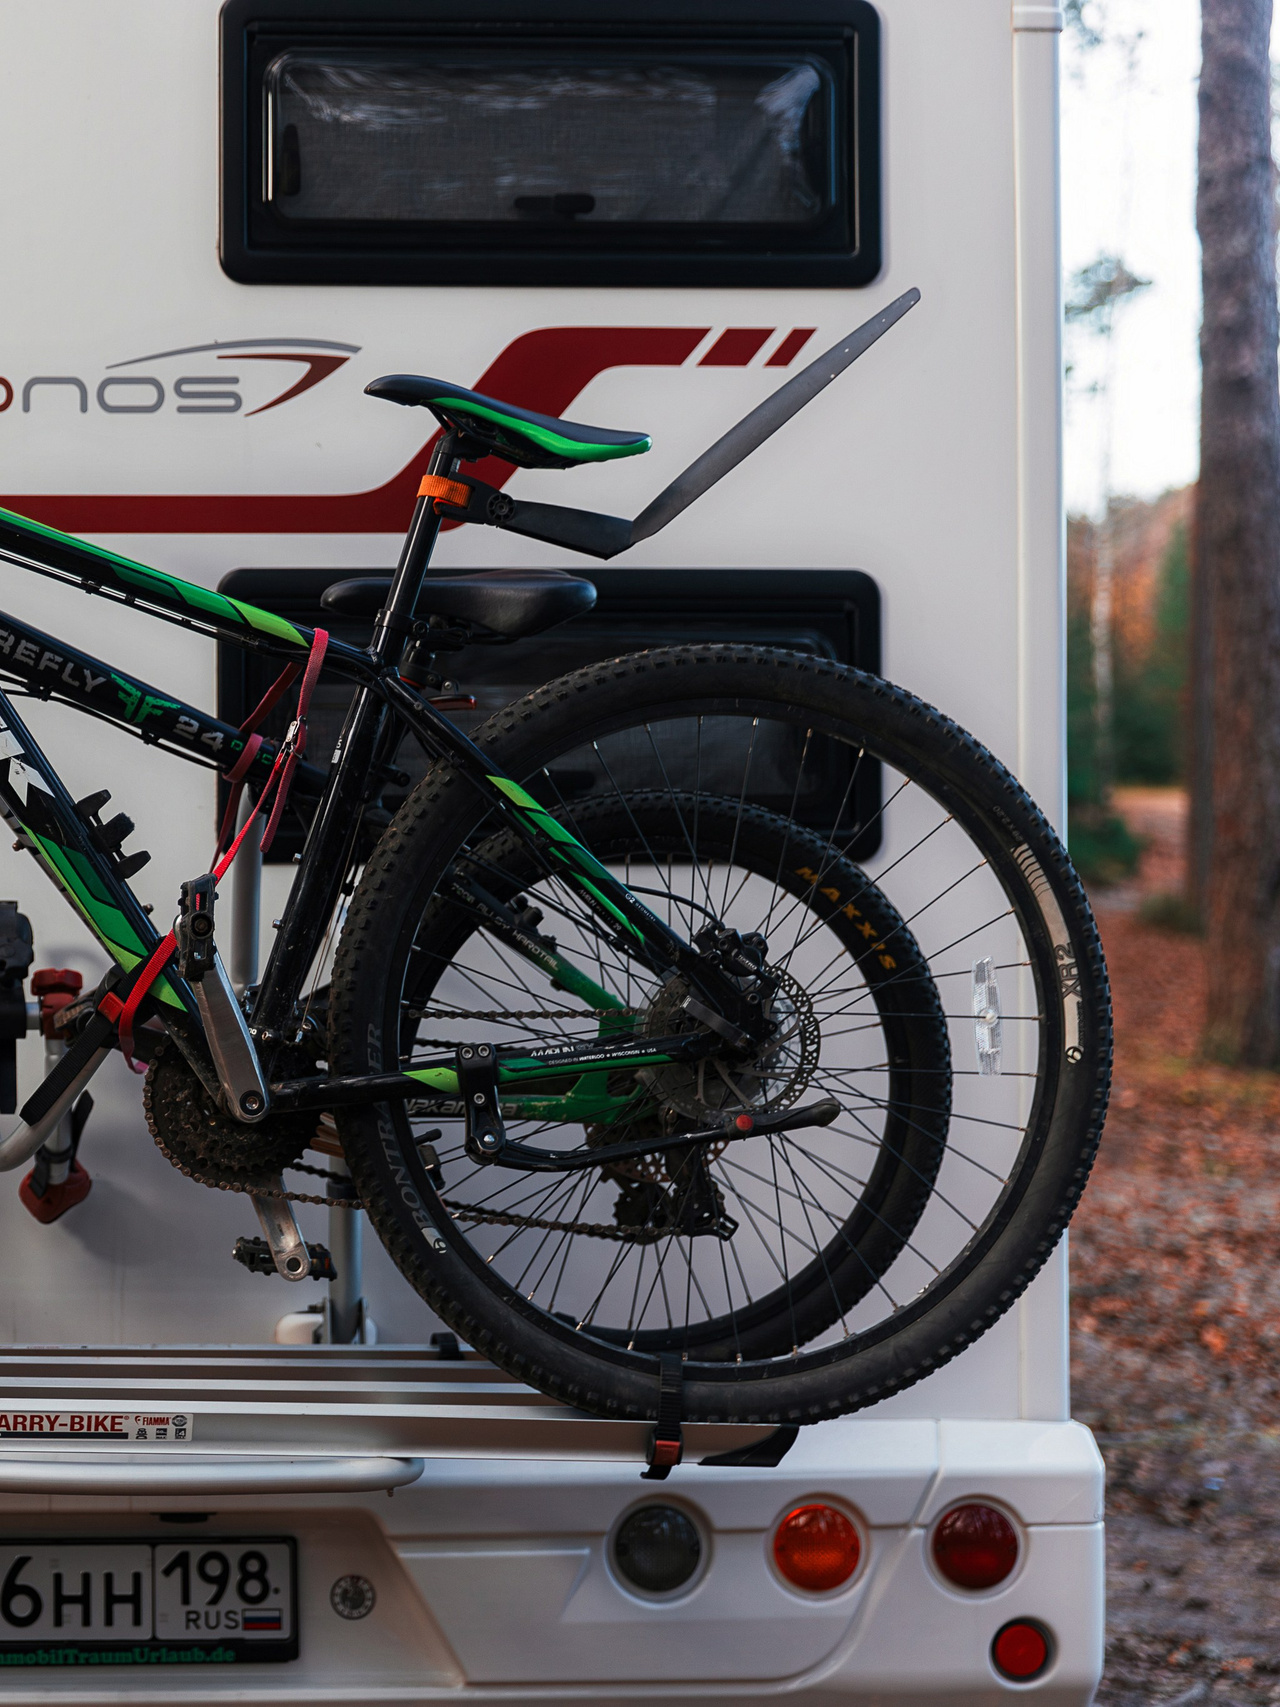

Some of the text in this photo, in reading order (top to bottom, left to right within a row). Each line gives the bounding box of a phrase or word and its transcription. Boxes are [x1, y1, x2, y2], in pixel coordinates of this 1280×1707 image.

[176, 714, 224, 752] 24
[230, 738, 273, 766] DC
[624, 892, 636, 904] G2
[794, 866, 897, 970] MAXXIS
[511, 930, 560, 972] HARDTAIL
[1054, 941, 1084, 1000] XR2
[548, 1057, 573, 1066] DESIGNED
[578, 1053, 605, 1062] WATERLOO
[611, 1049, 641, 1058] WISCONSIN
[367, 1022, 432, 1229] BONTRAER
[403, 1098, 519, 1117] Nakaa
[160, 1550, 271, 1607] 198
[185, 1610, 240, 1631] RUS
